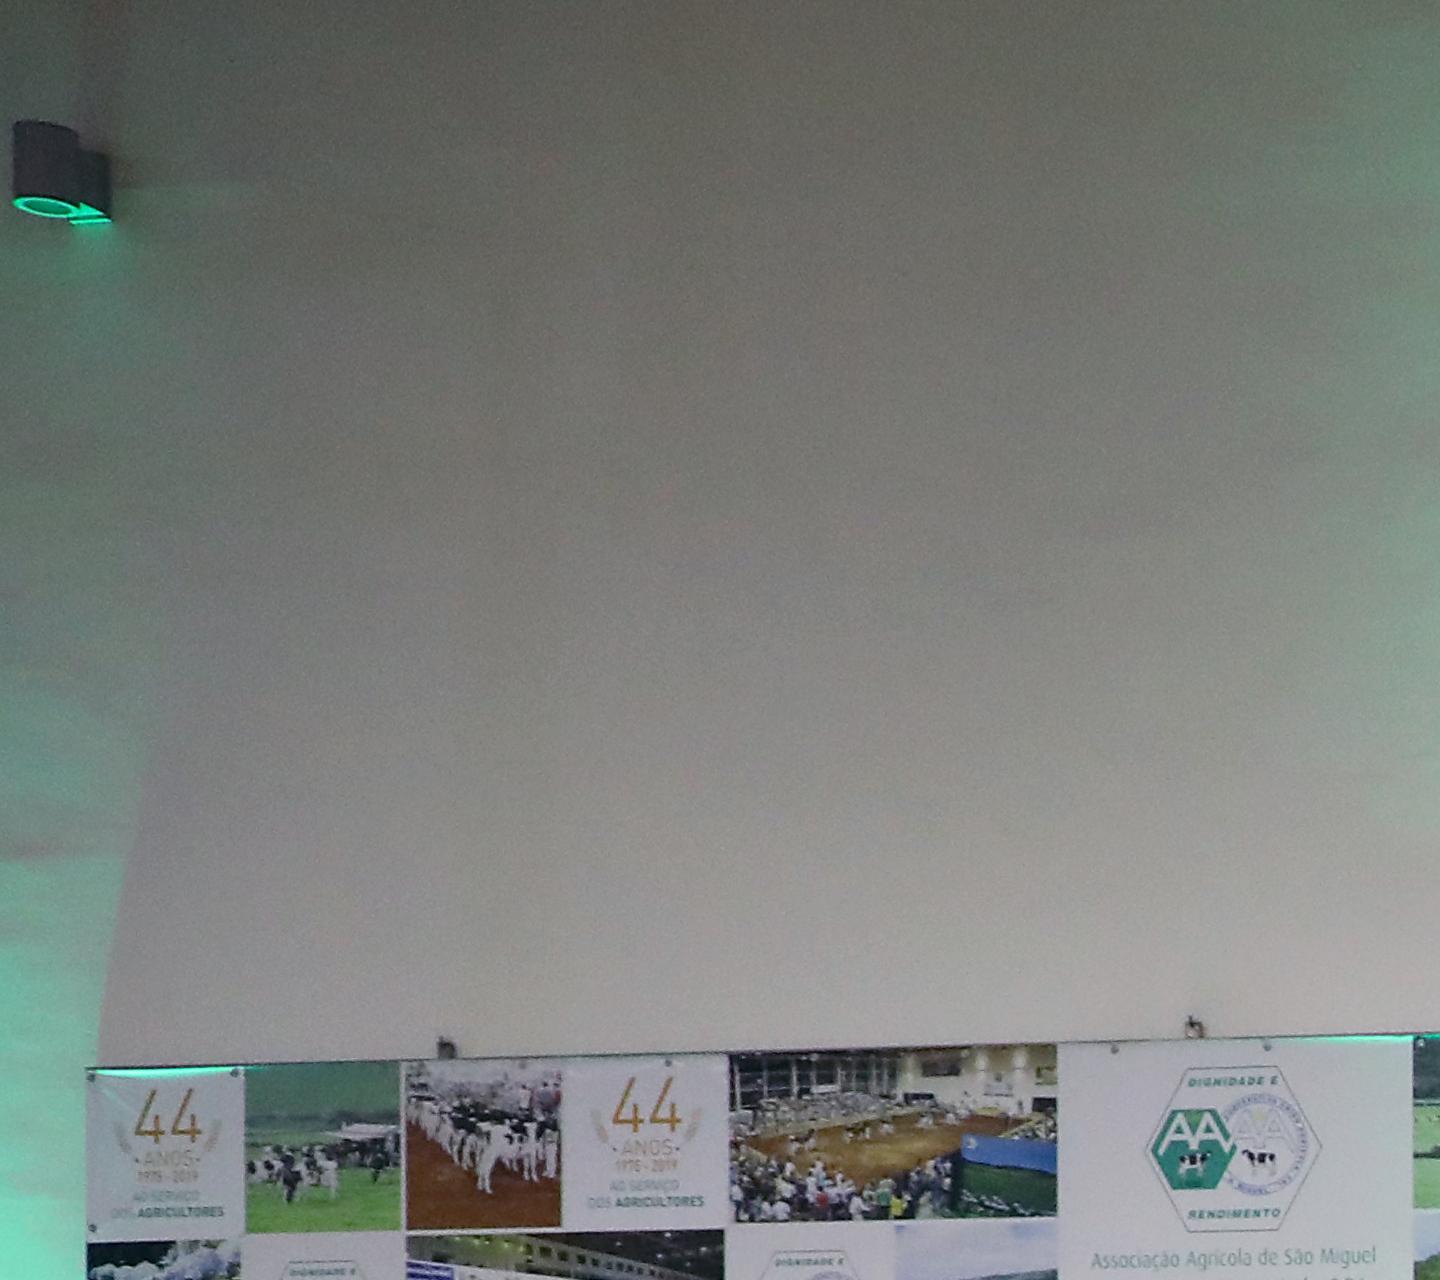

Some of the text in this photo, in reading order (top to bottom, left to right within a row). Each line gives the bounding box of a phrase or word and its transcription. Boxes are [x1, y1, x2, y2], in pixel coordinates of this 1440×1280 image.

[1187, 1075, 1279, 1087] DIGNIDADE E
[612, 1076, 682, 1133] 44
[134, 1088, 202, 1144] 44
[622, 1139, 673, 1156] ANOS
[615, 1195, 704, 1208] AGRICULTORES
[137, 1206, 224, 1218] AGRICULTORES
[1187, 1208, 1281, 1219] RENDIMENTO
[1091, 1251, 1180, 1272] Associação
[1257, 1248, 1278, 1266] de
[1284, 1247, 1313, 1265] São
[1320, 1246, 1376, 1269] Miguel
